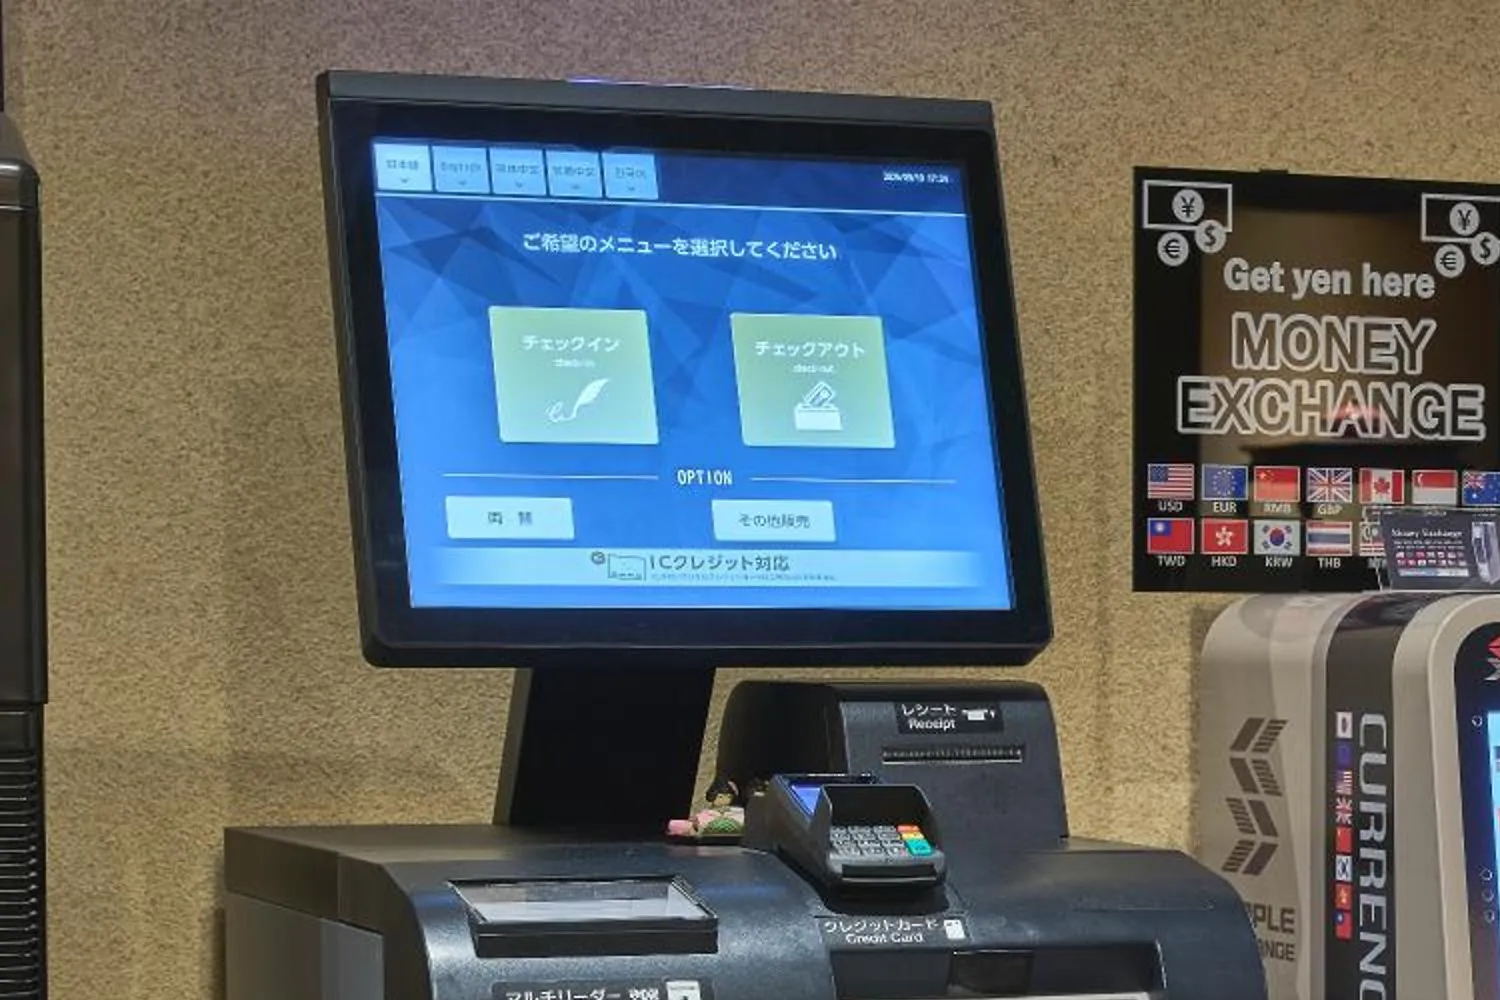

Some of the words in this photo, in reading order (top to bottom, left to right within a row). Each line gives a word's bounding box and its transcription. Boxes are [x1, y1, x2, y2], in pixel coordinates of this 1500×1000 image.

[522, 232, 838, 260] ご希望のメニューを選択してください
[1223, 257, 1285, 293] Get
[1291, 264, 1351, 299] yen
[1362, 263, 1436, 299] here
[522, 335, 621, 352] チェックイン
[755, 341, 866, 359] チェックアウト
[1231, 312, 1437, 374] MONEY
[1177, 375, 1486, 441] EXCHANGE
[677, 469, 734, 486] OPTION
[1158, 502, 1183, 513] USD
[1213, 502, 1237, 513] EUR
[1317, 504, 1344, 515] GBP
[738, 512, 811, 530] その他販売
[650, 553, 791, 572] ICクレジット対応
[1157, 555, 1185, 567] TWD
[1211, 556, 1237, 567] HKD
[1264, 556, 1293, 568] KRW
[1317, 557, 1342, 568] THB
[901, 702, 958, 717] レシート
[907, 717, 957, 732] Receipt
[824, 918, 939, 933] クレジットカード
[1245, 902, 1295, 934] PLE
[846, 932, 888, 945] Credit
[891, 932, 924, 943] Card
